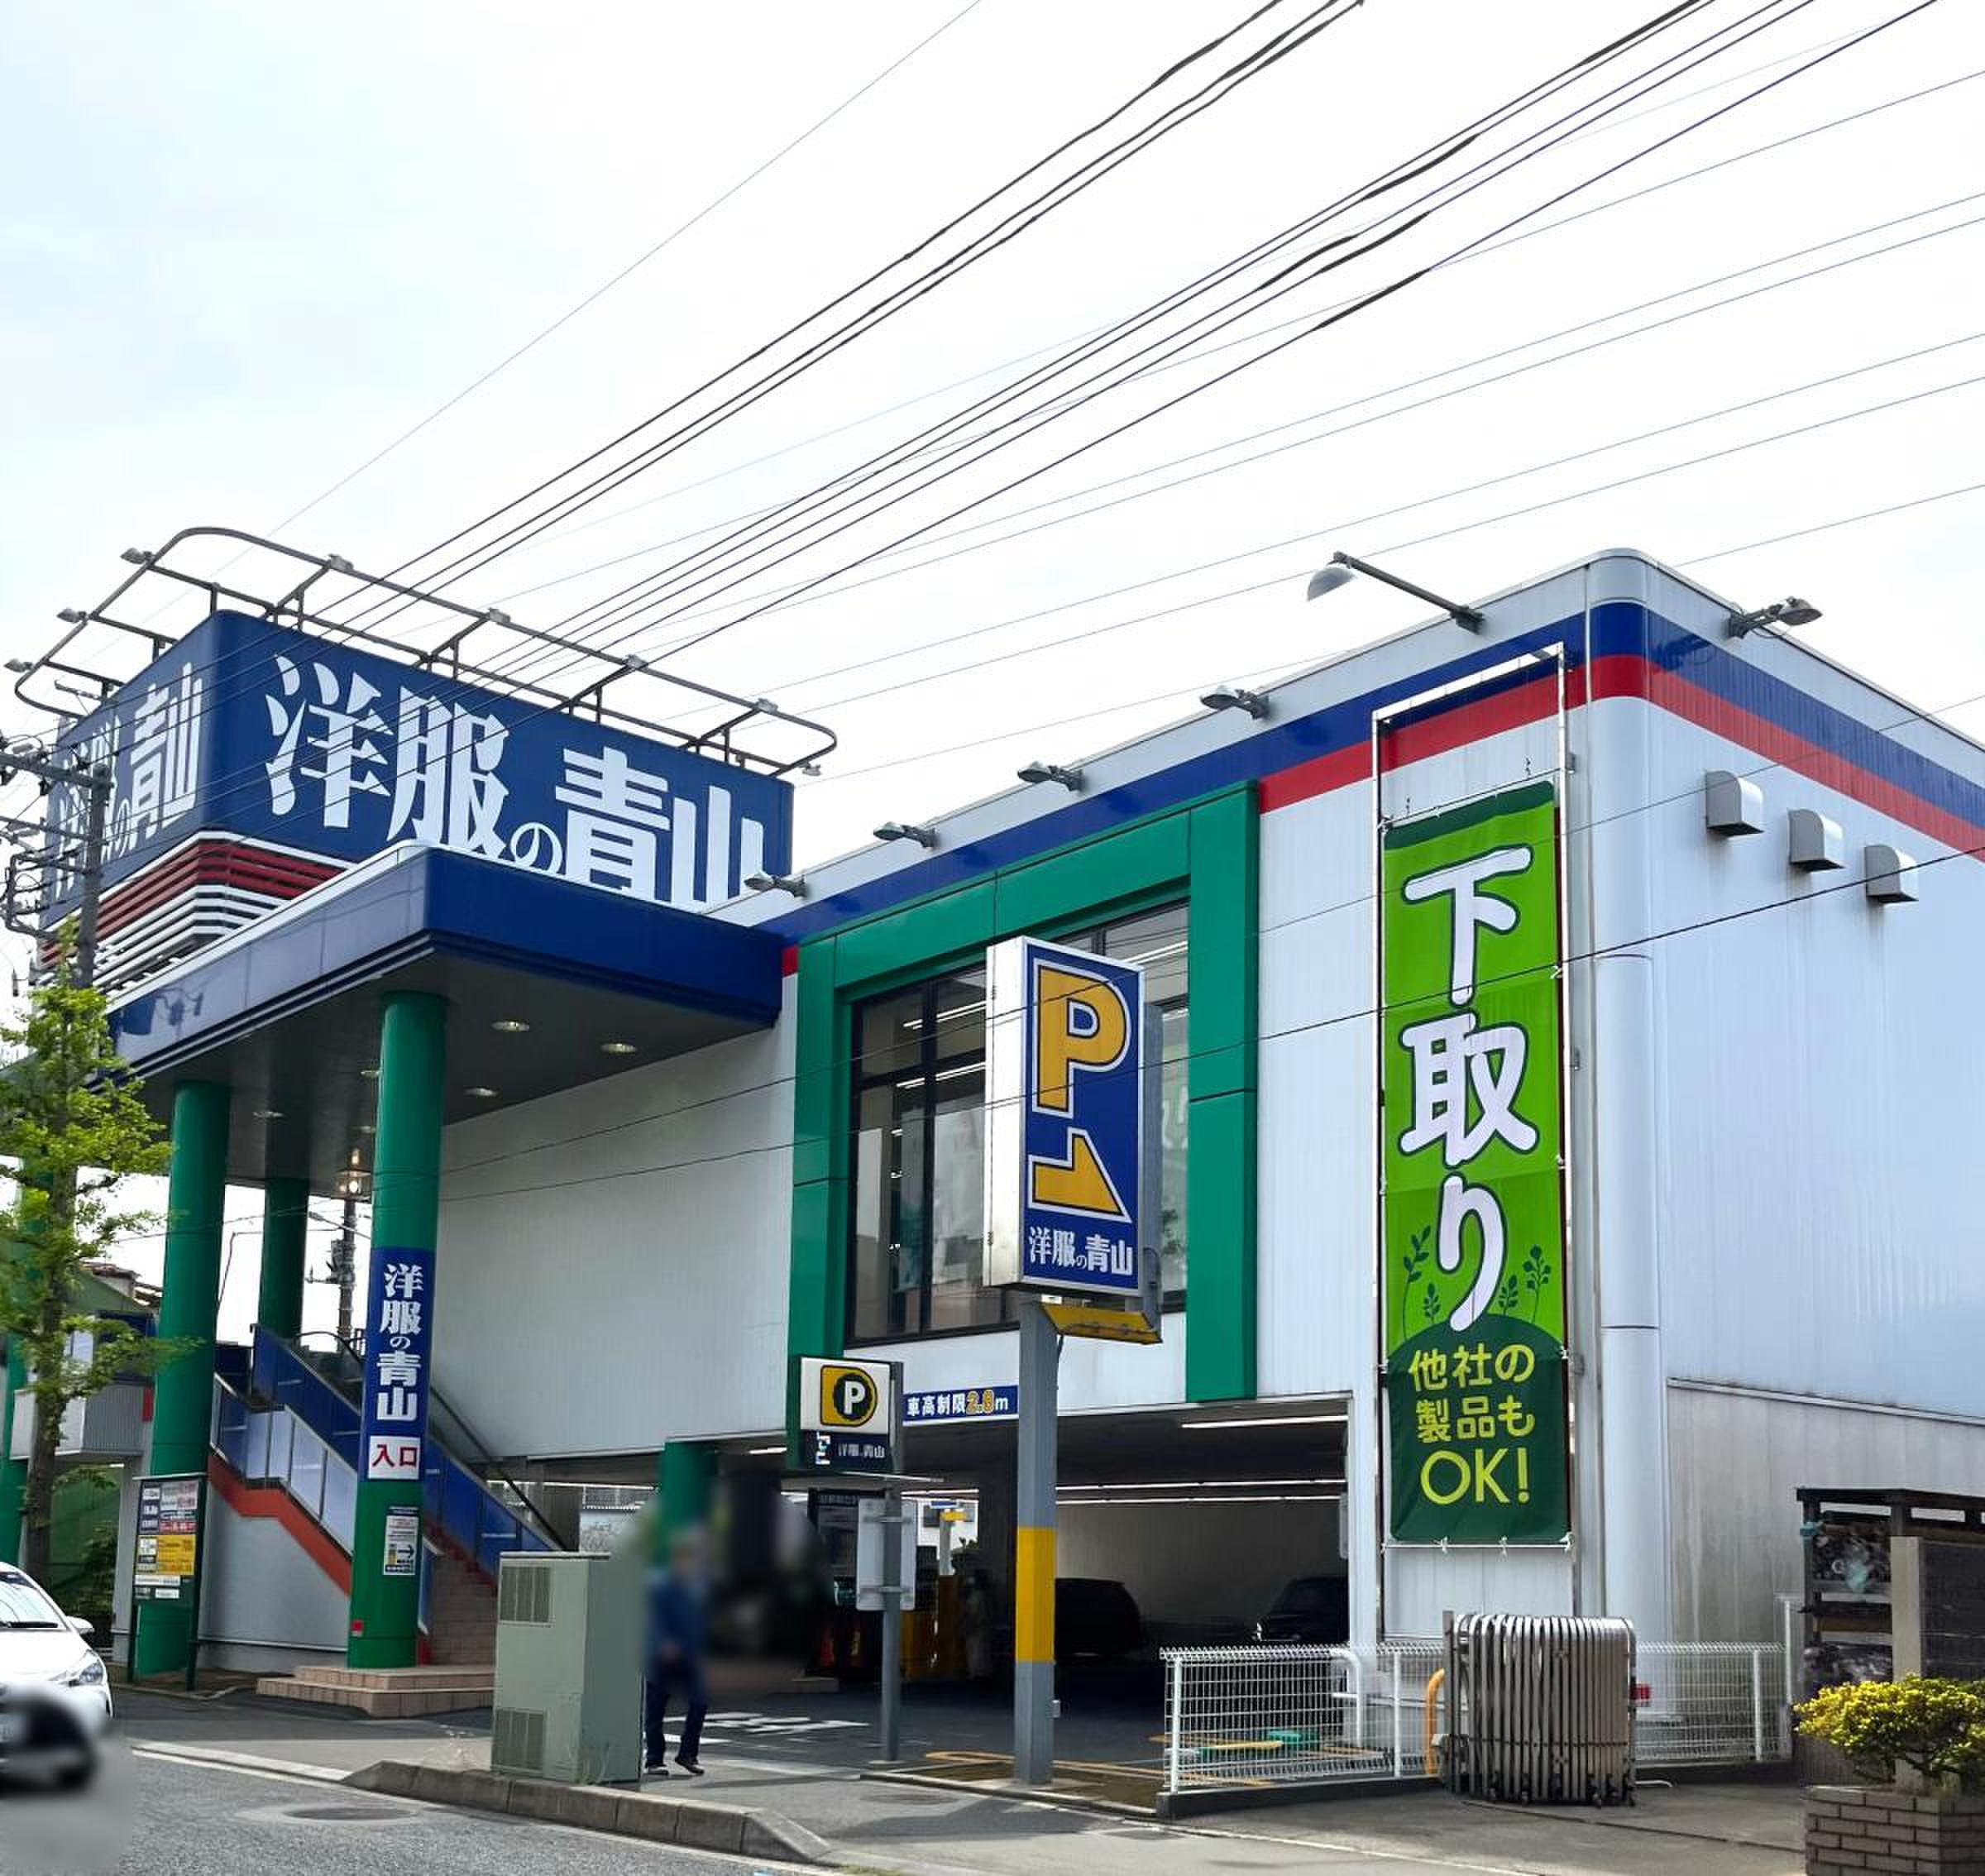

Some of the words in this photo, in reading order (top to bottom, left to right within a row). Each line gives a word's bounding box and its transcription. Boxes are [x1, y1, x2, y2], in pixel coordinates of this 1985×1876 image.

[265, 654, 763, 905] 洋服の青山
[1034, 960, 1130, 1117] P
[1399, 844, 1538, 1333] 下取り
[1028, 1226, 1134, 1276] 洋服の青山
[376, 1264, 424, 1421] 洋服の青山
[1409, 1343, 1535, 1391] 他社の
[844, 1381, 866, 1414] P
[1415, 1395, 1536, 1443] 製品も
[372, 1443, 418, 1467] 入口
[1420, 1447, 1530, 1505] OK!
